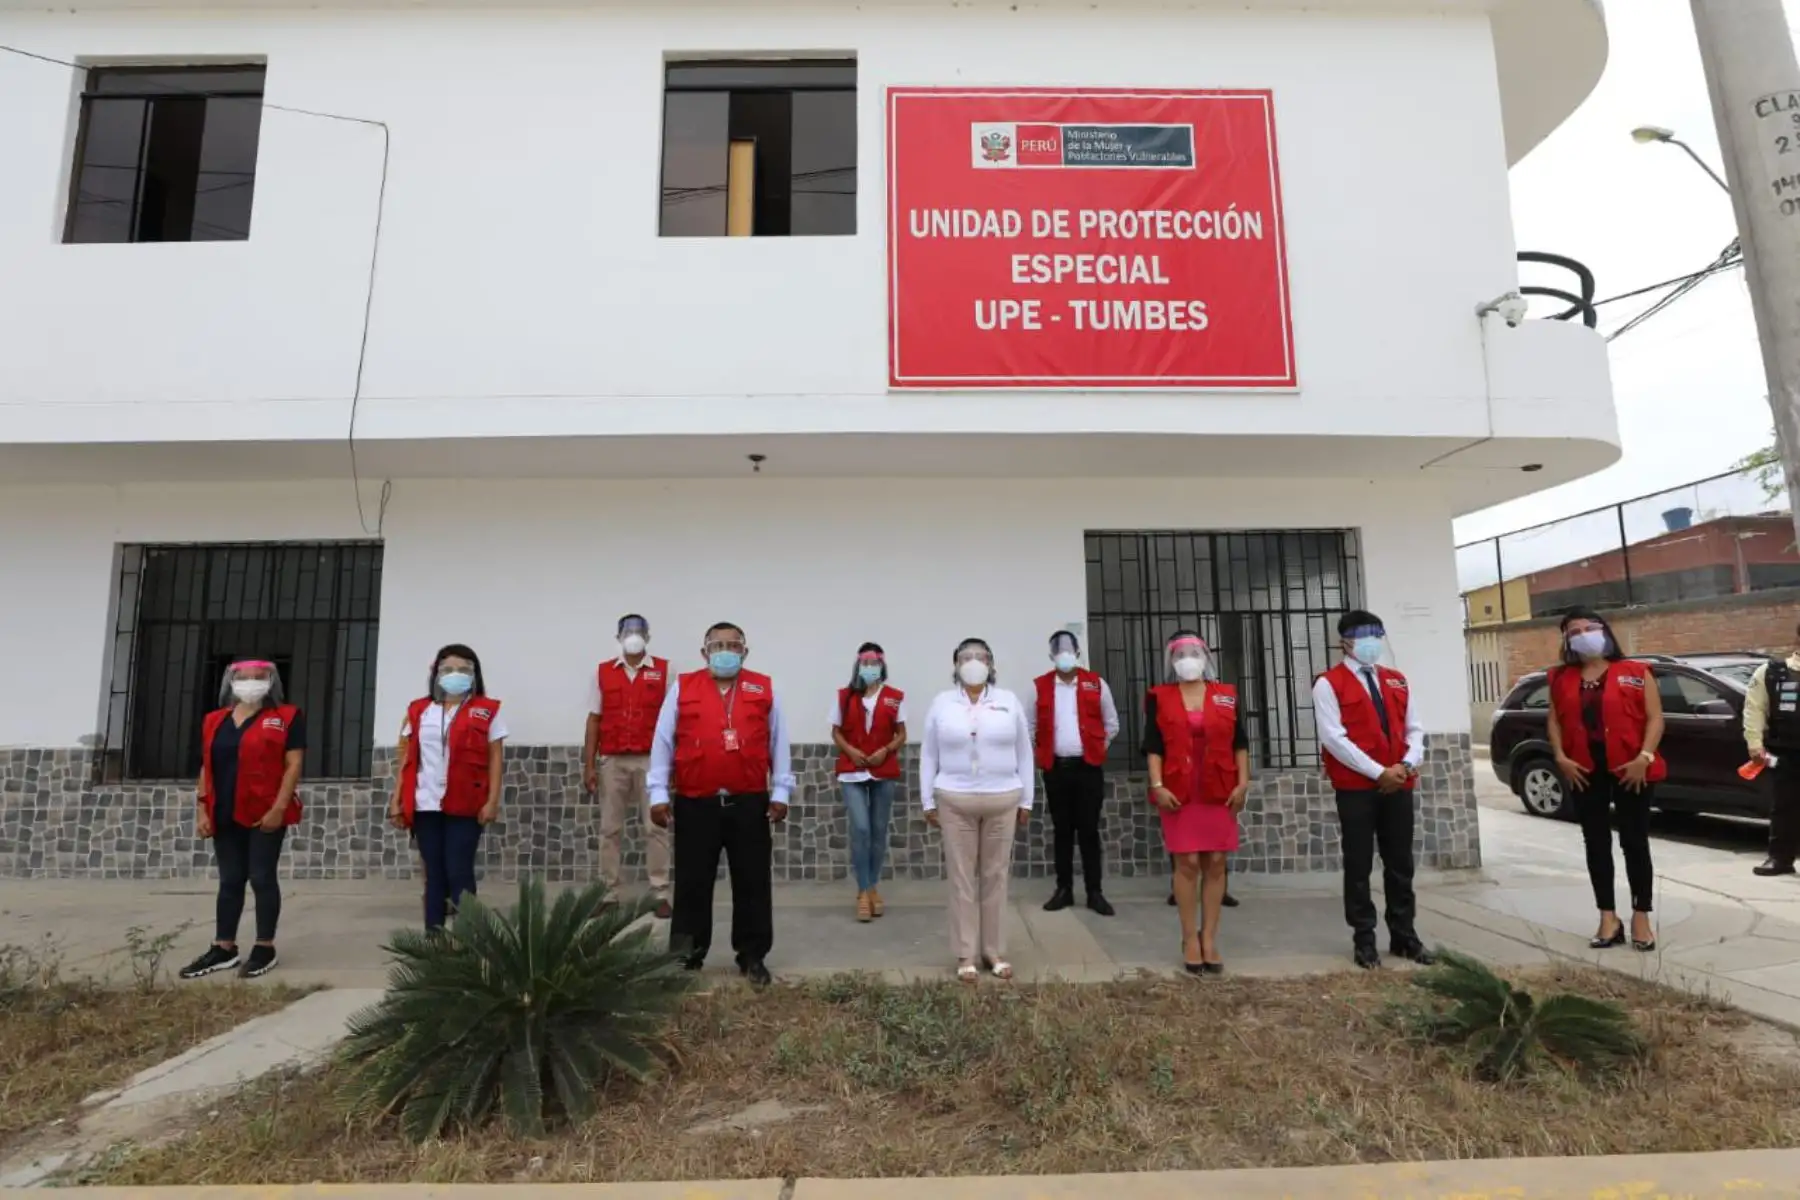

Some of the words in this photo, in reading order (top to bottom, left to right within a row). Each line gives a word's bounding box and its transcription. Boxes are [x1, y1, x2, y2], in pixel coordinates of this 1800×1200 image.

[1067, 129, 1118, 140] Ministerio
[1021, 136, 1057, 152] PERÚ
[1067, 140, 1080, 150] de
[1082, 140, 1092, 150] la
[1094, 140, 1123, 152] Mujer
[1126, 143, 1133, 152] y
[1067, 151, 1127, 161] Poblaciones
[1129, 150, 1186, 161] Vulnerables
[910, 209, 1022, 238] UNIDAD
[1031, 209, 1070, 238] DE
[1079, 202, 1263, 240] PROTECCIÓN
[1011, 254, 1170, 284] ESPECIAL
[975, 300, 1042, 330] UPE
[1068, 300, 1208, 330] TUMBES
